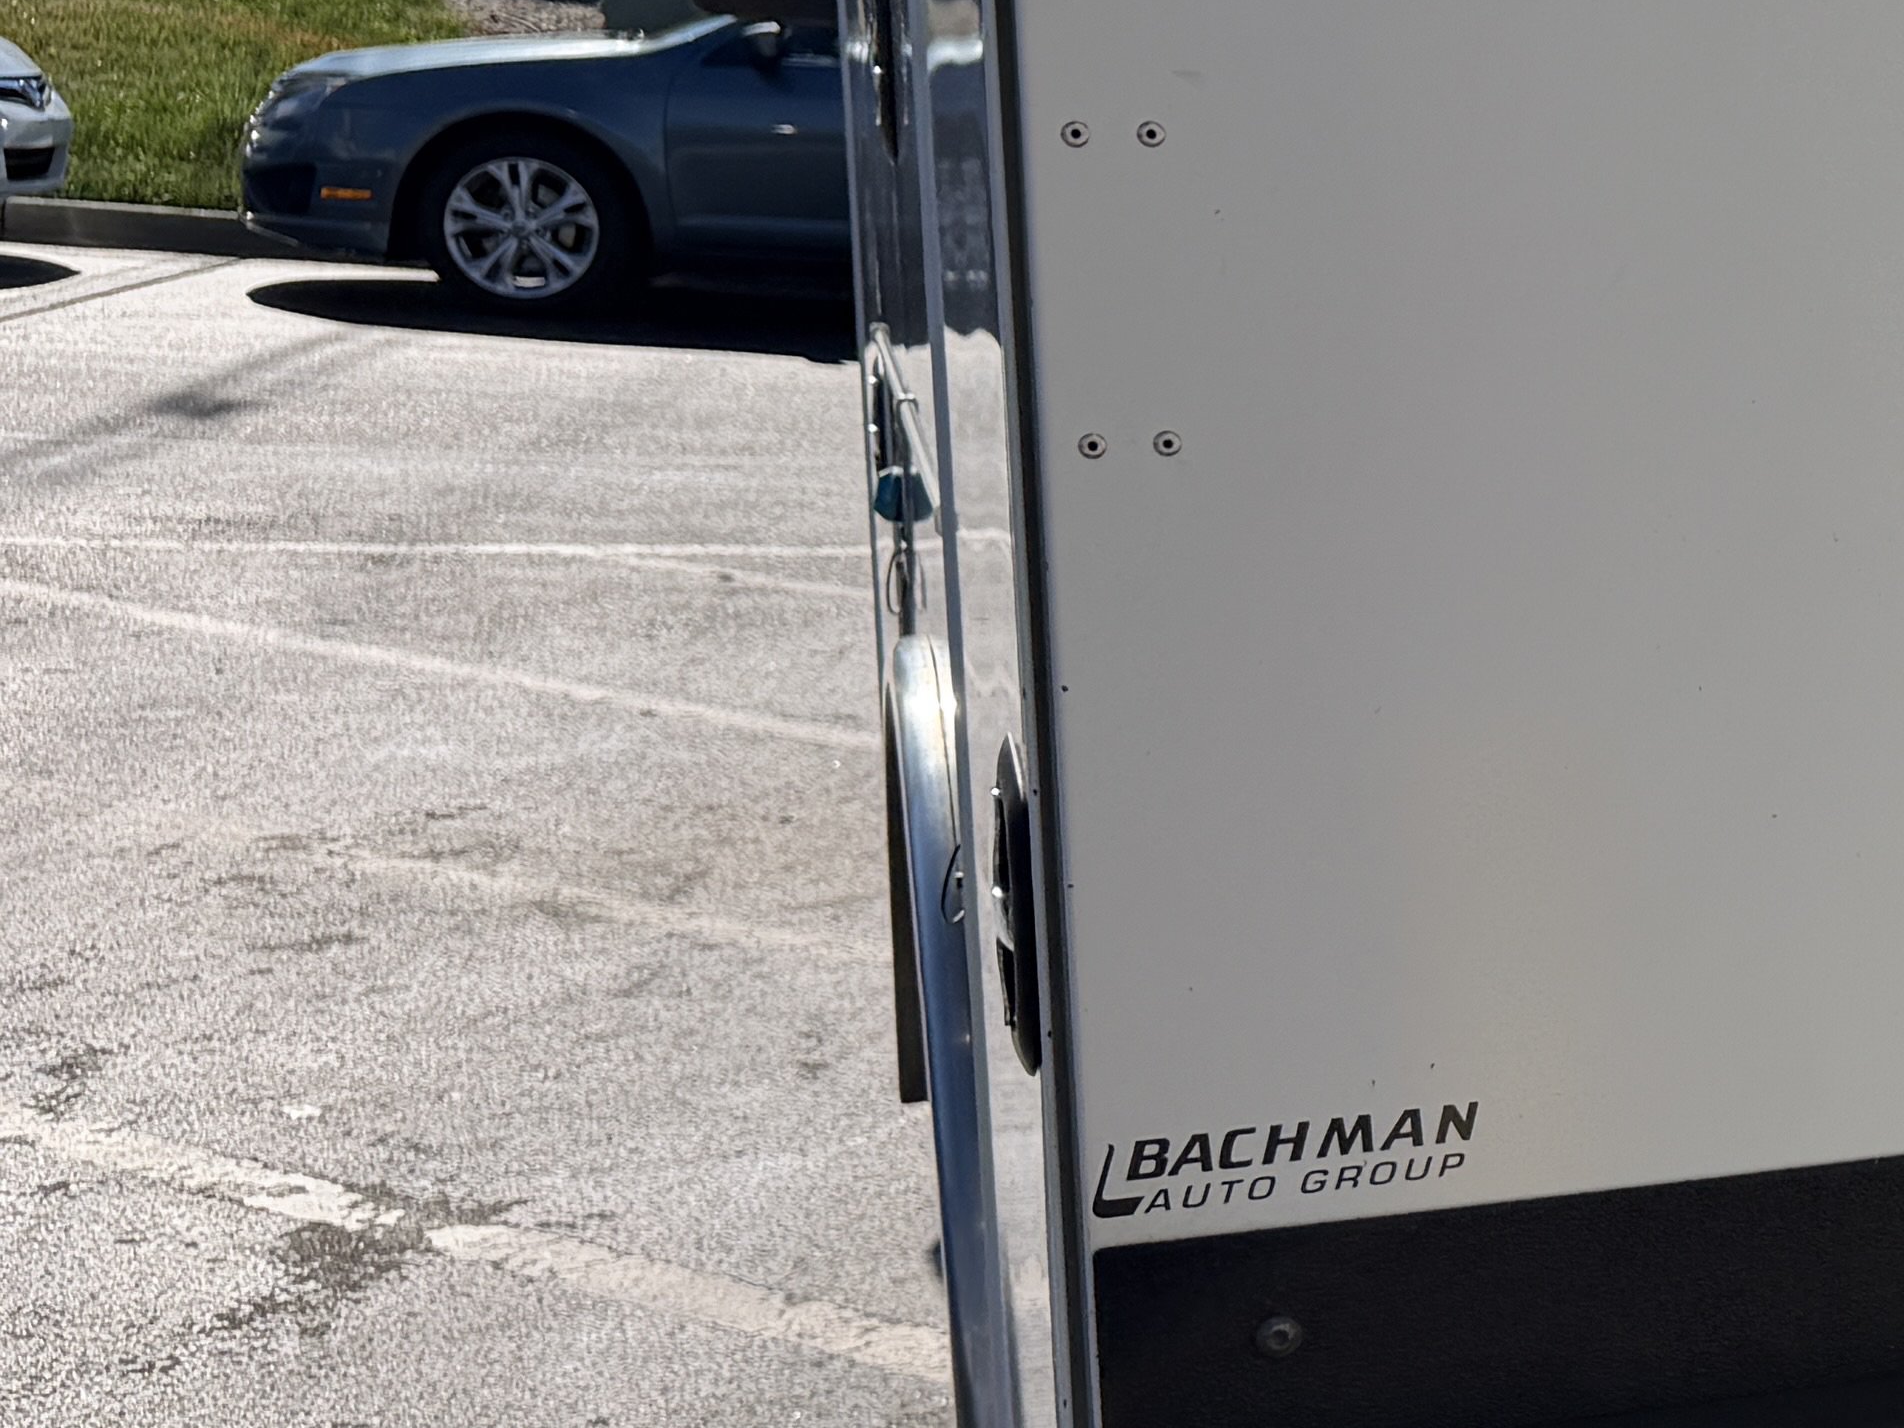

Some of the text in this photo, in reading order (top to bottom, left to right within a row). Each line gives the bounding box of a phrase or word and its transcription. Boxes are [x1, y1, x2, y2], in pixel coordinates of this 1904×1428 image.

[1126, 1101, 1479, 1182] BACHMAN
[1144, 1153, 1466, 1215] AUTO GROUP
